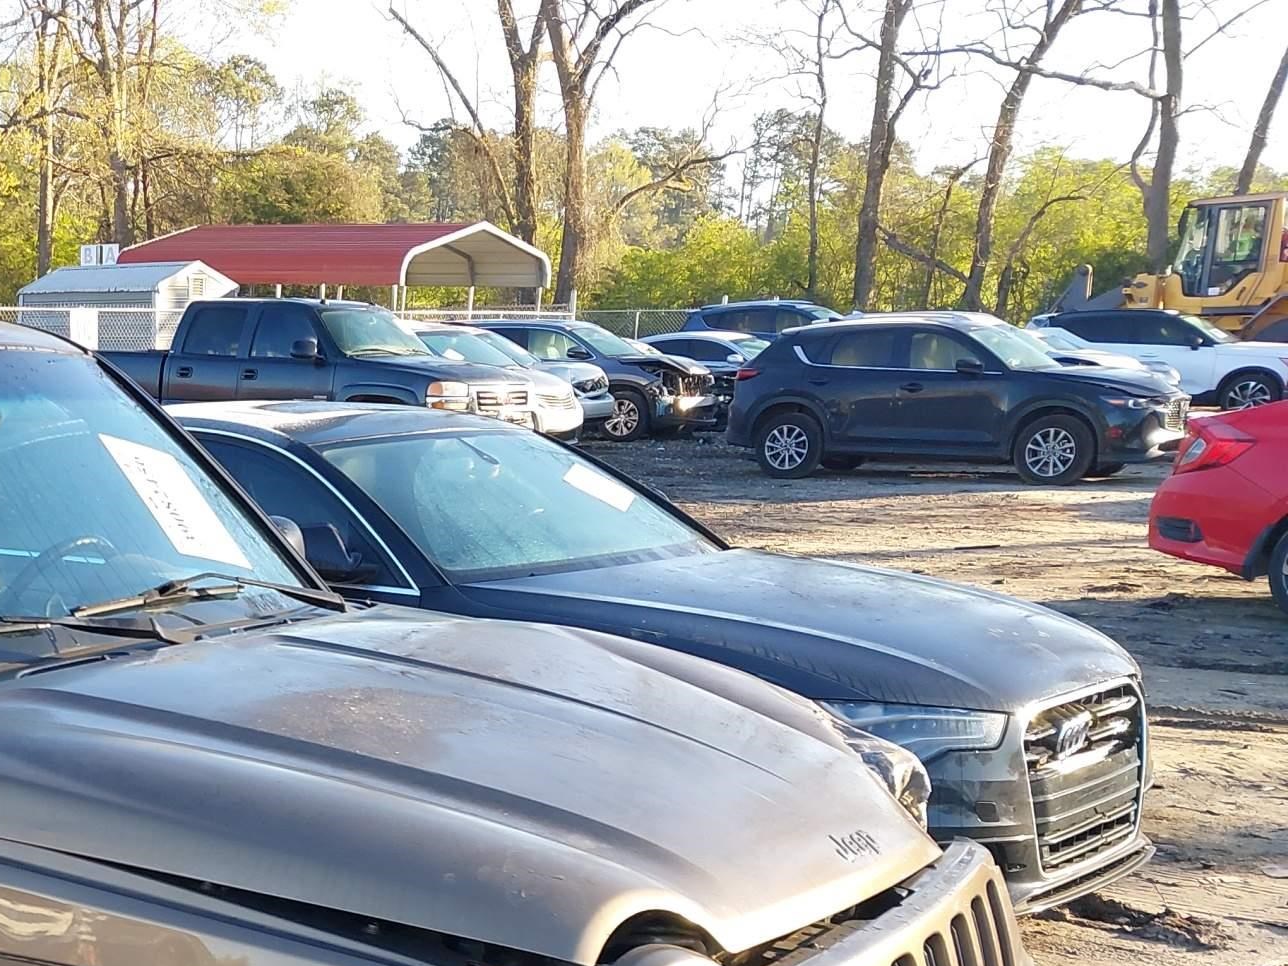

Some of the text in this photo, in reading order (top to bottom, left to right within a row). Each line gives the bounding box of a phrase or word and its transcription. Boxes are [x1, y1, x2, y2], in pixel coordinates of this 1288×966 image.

[84, 247, 93, 265] B
[104, 246, 116, 264] A
[828, 829, 880, 863] Jeep
